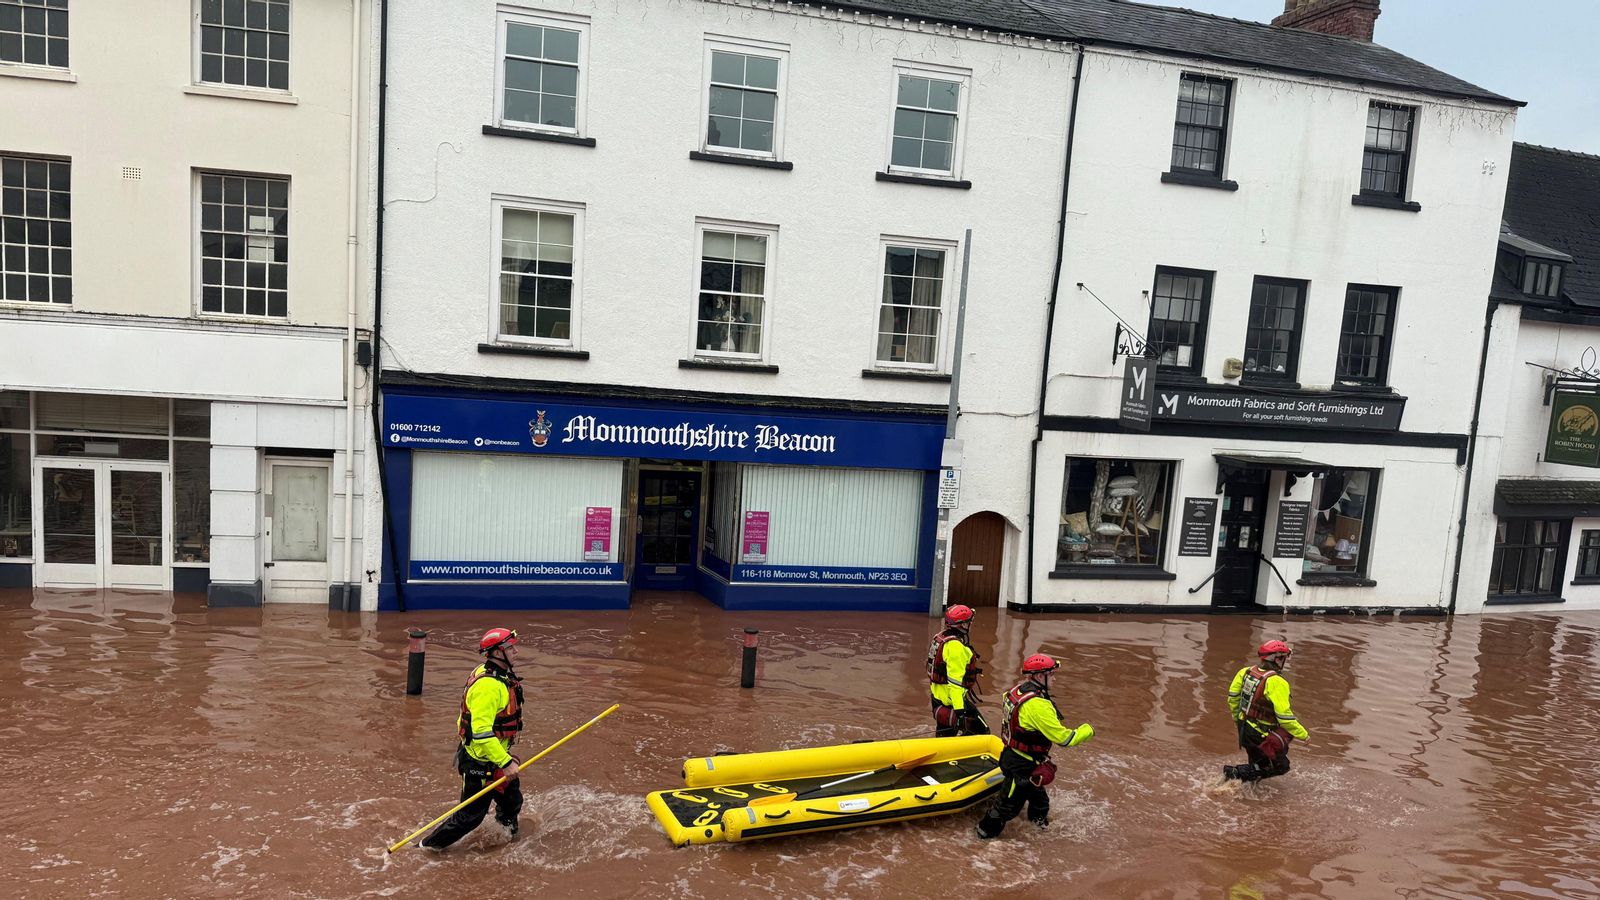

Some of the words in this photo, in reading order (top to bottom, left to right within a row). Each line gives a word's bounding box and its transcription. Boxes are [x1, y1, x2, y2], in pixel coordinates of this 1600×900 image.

[1187, 395, 1241, 408] Monmouth
[1243, 398, 1275, 410] Fabrics
[1277, 401, 1295, 411] and
[1297, 401, 1316, 412] Soft
[1317, 402, 1368, 417] Furnishings
[1369, 405, 1385, 416] Ltd
[1260, 413, 1274, 421] your
[1284, 414, 1311, 423] furnishing
[390, 423, 413, 432] 01600
[414, 424, 441, 433] 712142
[561, 414, 750, 451] Monmouthshire
[754, 424, 836, 453] Beacon
[401, 436, 468, 445] @MonmouthshireBeacon
[421, 564, 612, 576] www.monmouthshirebeacon.co.uk
[741, 569, 772, 578] 116-118
[773, 570, 808, 579] Monnow
[809, 571, 820, 580] St,
[822, 571, 866, 581] Monmouth,
[868, 572, 890, 581] NP25
[890, 573, 908, 582] 3EQ
